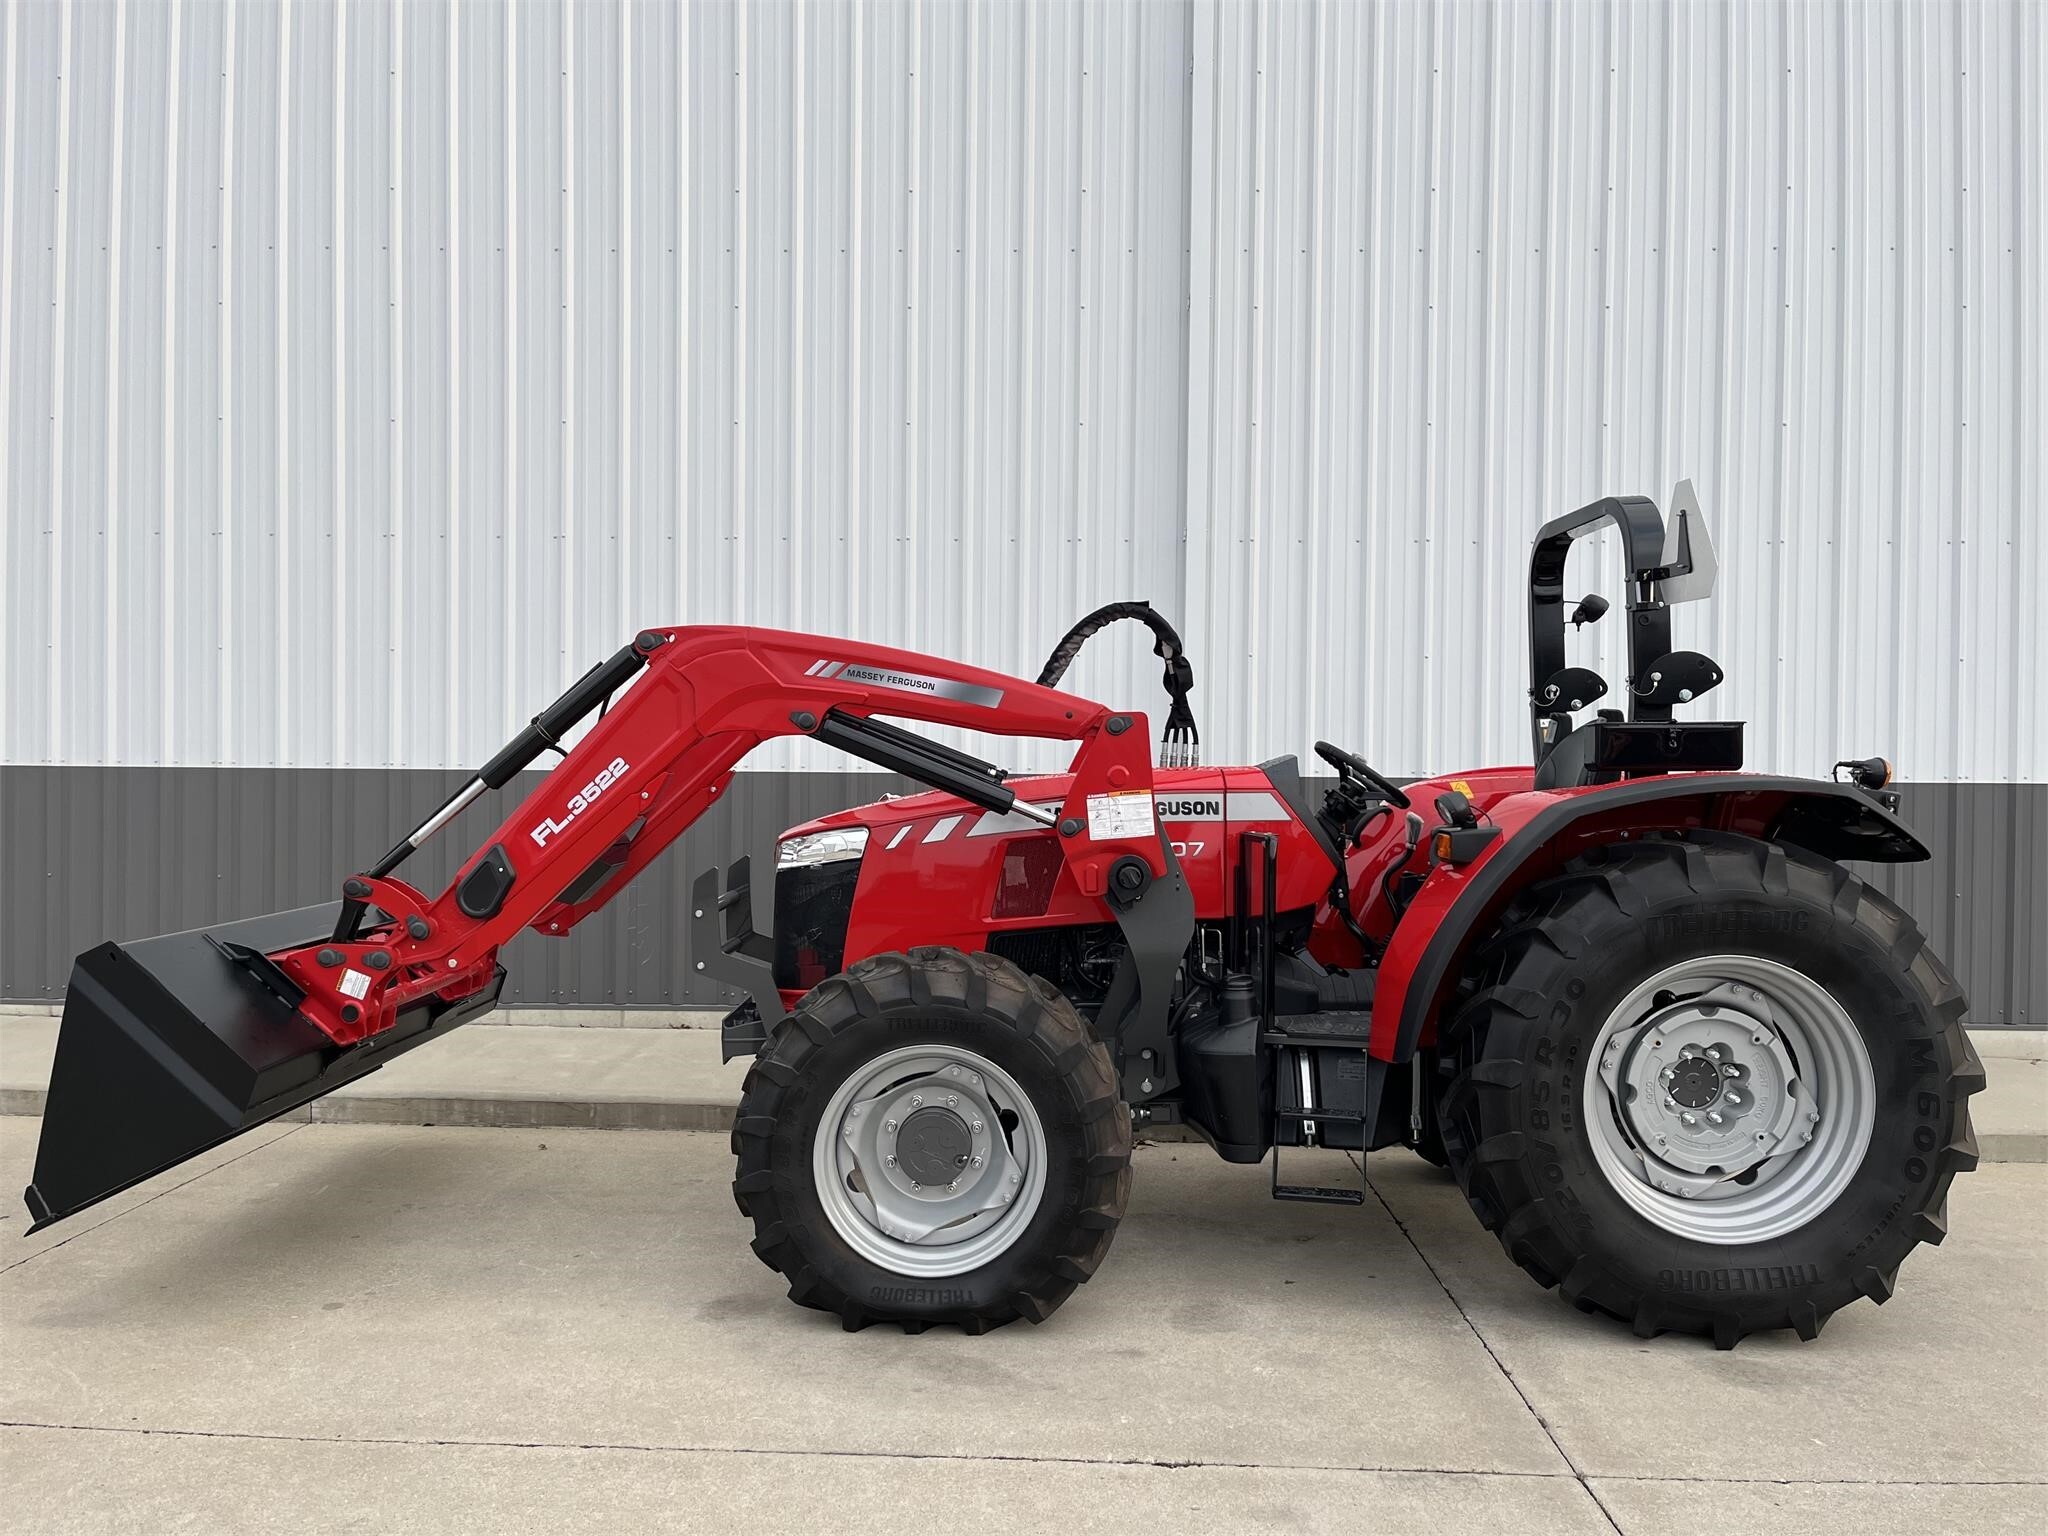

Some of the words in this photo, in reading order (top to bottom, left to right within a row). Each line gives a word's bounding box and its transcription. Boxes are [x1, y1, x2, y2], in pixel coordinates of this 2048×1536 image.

[847, 669, 885, 682] MASSEY
[887, 675, 936, 691] FERGUSON
[530, 757, 630, 848] FL.3522
[1156, 801, 1219, 816] GUSON
